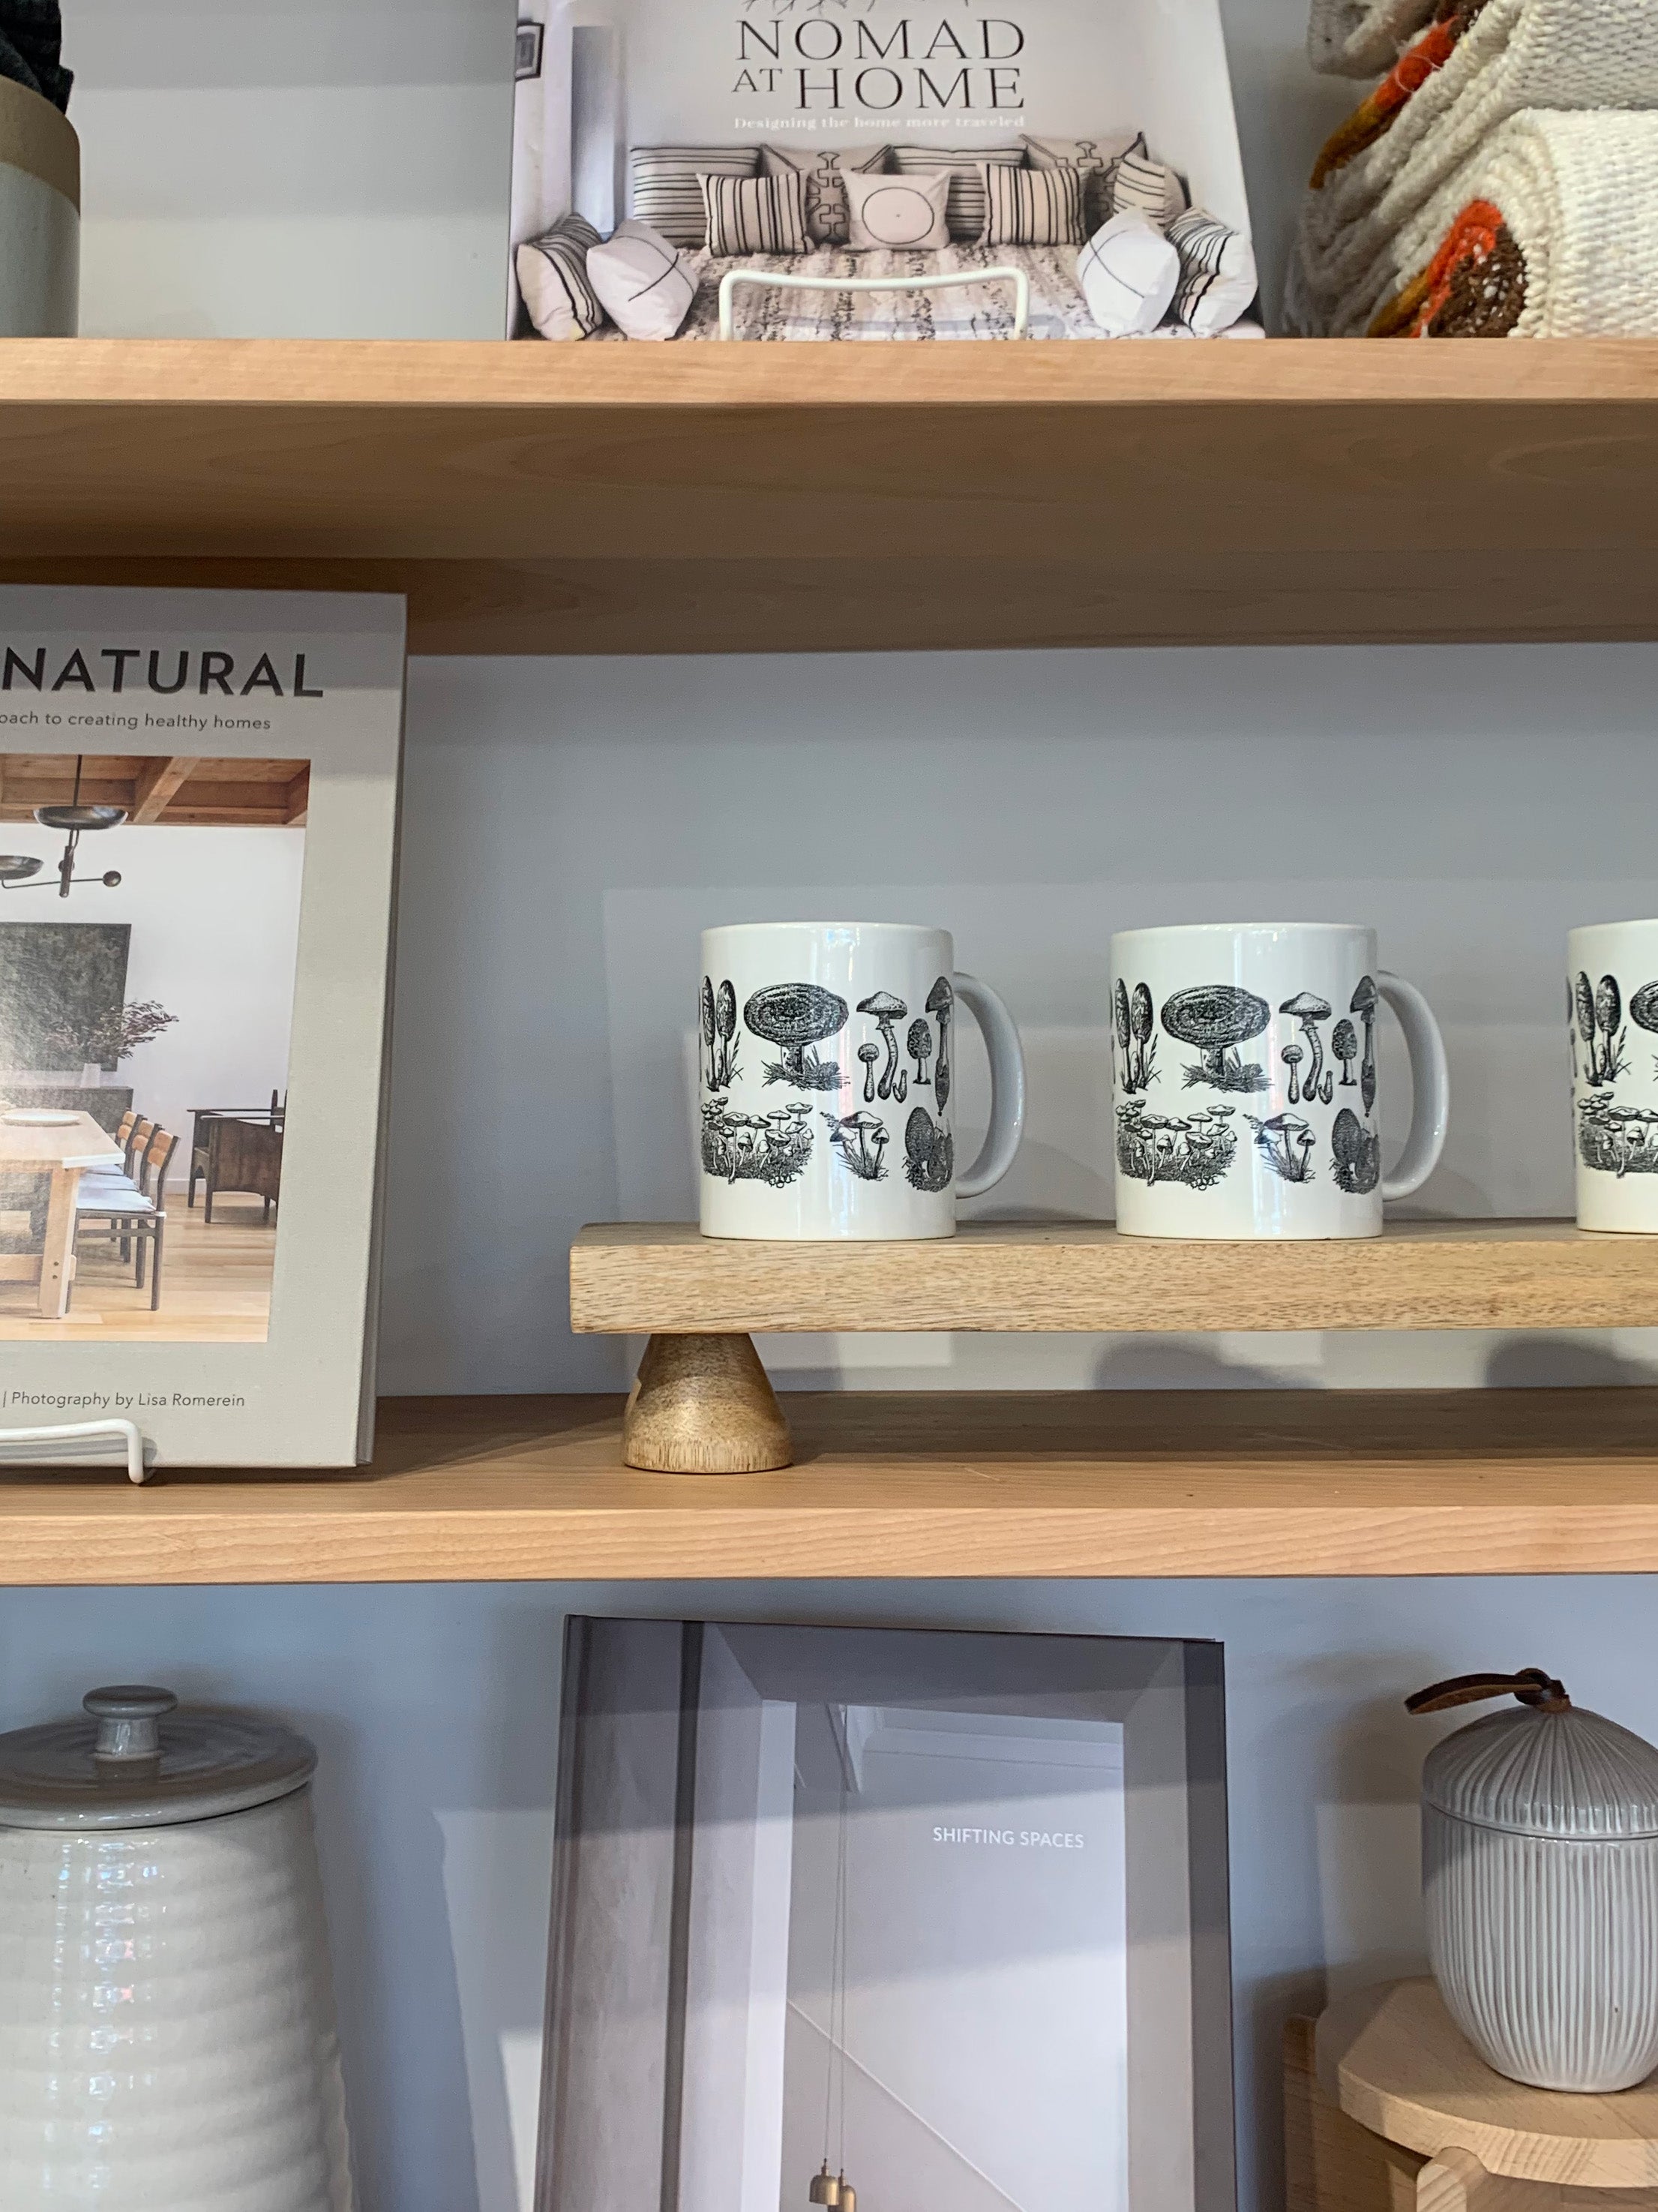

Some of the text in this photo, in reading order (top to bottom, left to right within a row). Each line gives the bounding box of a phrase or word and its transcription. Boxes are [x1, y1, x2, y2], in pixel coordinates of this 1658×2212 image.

[736, 19, 1024, 61] NOMAD
[732, 68, 1024, 110] AT HOME
[734, 116, 1025, 131] Designing the home more traveled
[1, 647, 324, 698] NATURAL
[45, 713, 62, 725] to
[67, 713, 138, 731] creating
[145, 713, 208, 731] healthy
[214, 716, 271, 731] homes
[11, 1391, 111, 1409] Photography
[115, 1392, 133, 1409] by
[138, 1392, 167, 1406] Lisa
[172, 1393, 245, 1407] Romerein
[933, 1826, 1085, 1849] SHIFTING SPACES
